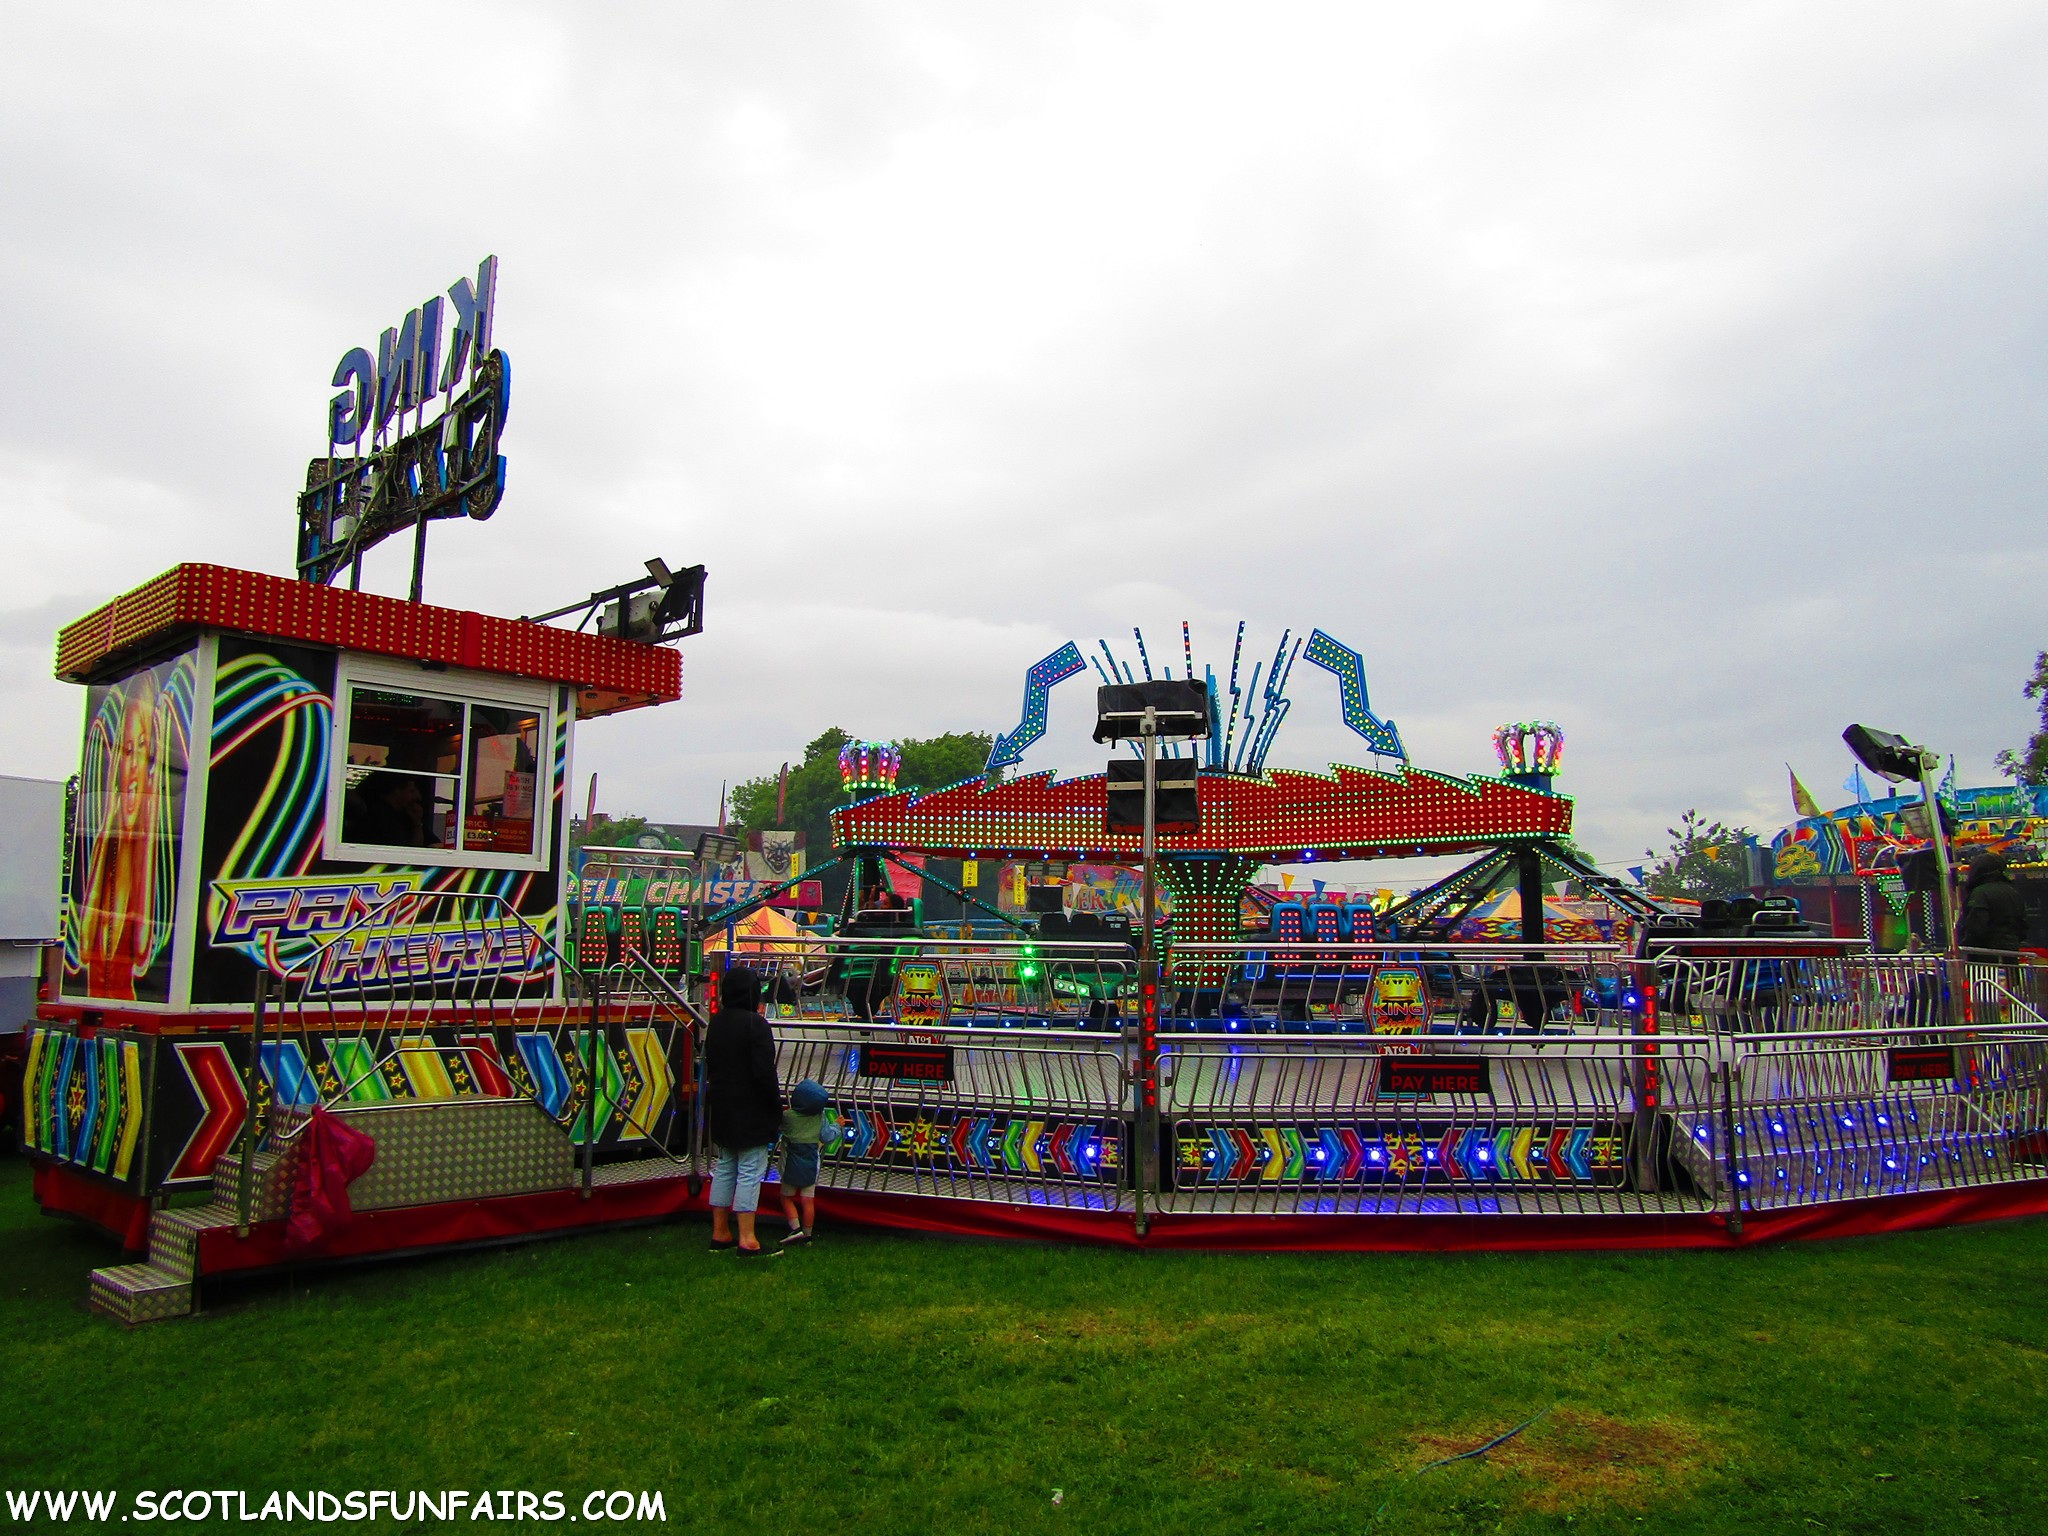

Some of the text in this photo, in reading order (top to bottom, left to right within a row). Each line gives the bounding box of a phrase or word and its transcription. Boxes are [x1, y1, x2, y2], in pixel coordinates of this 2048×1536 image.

[227, 881, 411, 932] PAY
[320, 925, 538, 985] HERE
[898, 994, 944, 1008] KING
[1373, 1002, 1424, 1016] KING
[869, 1061, 945, 1078] PAY HERE
[1895, 1063, 1951, 1078] PAY HERE
[1391, 1076, 1479, 1090] PAY HERE
